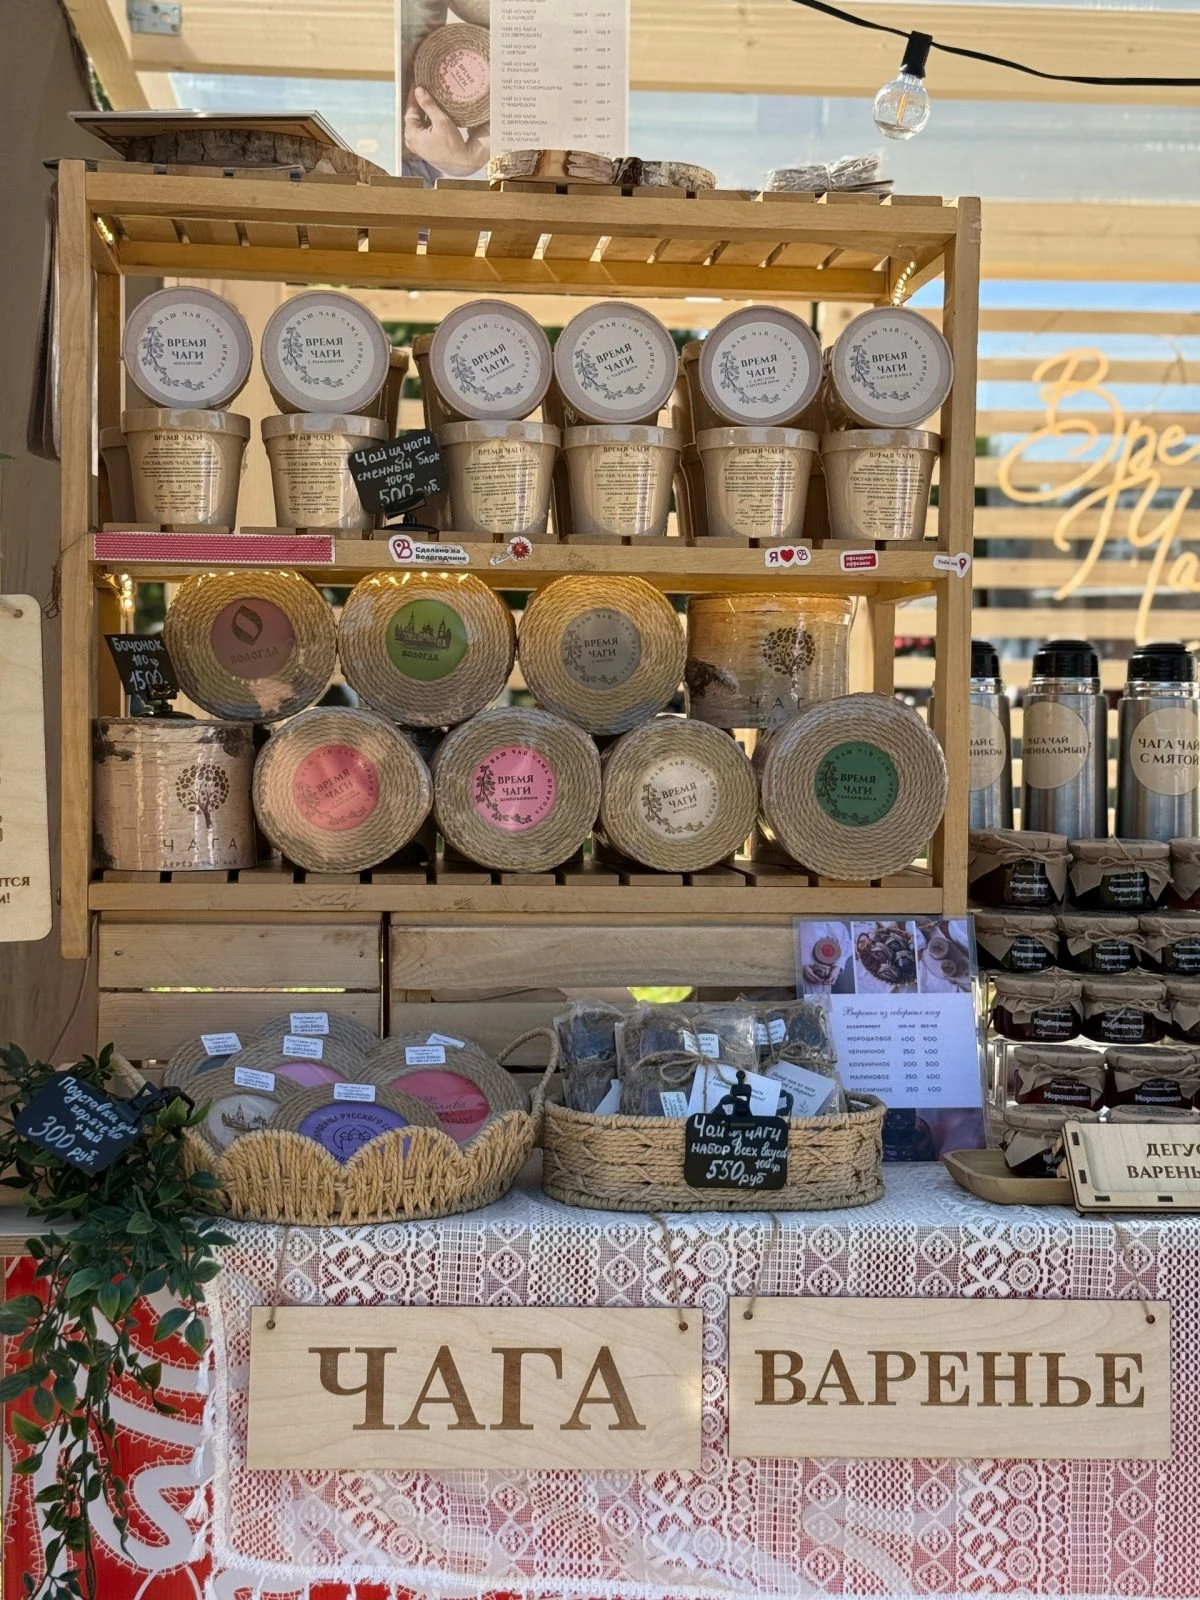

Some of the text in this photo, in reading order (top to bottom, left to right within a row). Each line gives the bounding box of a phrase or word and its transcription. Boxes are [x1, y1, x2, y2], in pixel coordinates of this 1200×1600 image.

[167, 338, 207, 348] ВРЕМЯ
[305, 337, 344, 347] ВРЕМЯ
[171, 350, 204, 360] ЧАГИ
[310, 349, 341, 359] ЧАГИ
[471, 343, 507, 367] ВРЕМЯ
[596, 342, 633, 364] ВРЕМЯ
[872, 351, 908, 363] ВРЕМЯ
[480, 355, 511, 374] ЧАГИ
[604, 355, 635, 373] ЧАГИ
[741, 354, 778, 368] ВРЕМЯ
[746, 366, 777, 378] ЧАГИ
[877, 364, 906, 374] ЧАГИ
[355, 448, 387, 466] Чай
[403, 436, 431, 452] чаги
[358, 451, 440, 482] сменный блок
[415, 546, 449, 555] Сделано
[769, 552, 779, 563] Я
[415, 554, 467, 562] Вологодчине
[112, 637, 165, 652] Бочонок
[584, 637, 618, 648] ВРЕМЯ
[230, 646, 279, 664] ВОЛОГДА
[401, 650, 439, 661] ВОЛОГДА
[588, 648, 616, 658] ЧАГИ
[1048, 735, 1069, 744] ЧАЙ
[1138, 738, 1200, 752] ЧАГА ЧАЙ
[1139, 753, 1200, 769] С МЯТОЙ
[316, 768, 351, 793] ВРЕМЯ
[497, 775, 534, 785] ВРЕМЯ
[840, 773, 876, 784] ВРЕМЯ
[325, 779, 353, 798] ЧАГИ
[502, 786, 532, 796] ЧАГИ
[661, 781, 698, 799] ВРЕМЯ
[843, 785, 873, 795] ЧАГИ
[668, 793, 698, 808] ЧАГИ
[163, 838, 238, 853] ЧАГА
[1011, 951, 1047, 960] Черничное
[1096, 952, 1131, 961] Черничное
[1101, 1020, 1145, 1031] Клубничное
[1043, 1090, 1092, 1102] Морошковое
[1135, 1092, 1182, 1103] Морошковое
[58, 1076, 139, 1134] Подставка для
[70, 1104, 123, 1139] горячего
[693, 1114, 726, 1138] Чай
[28, 1116, 76, 1149] 300
[66, 1147, 100, 1165] руб.
[691, 1142, 730, 1156] НАБОР
[733, 1142, 768, 1157] всех
[706, 1158, 768, 1187] 550 руб
[754, 1349, 1146, 1409] ВАРЕНЬЕ
[308, 1345, 647, 1431] ЧАГА
